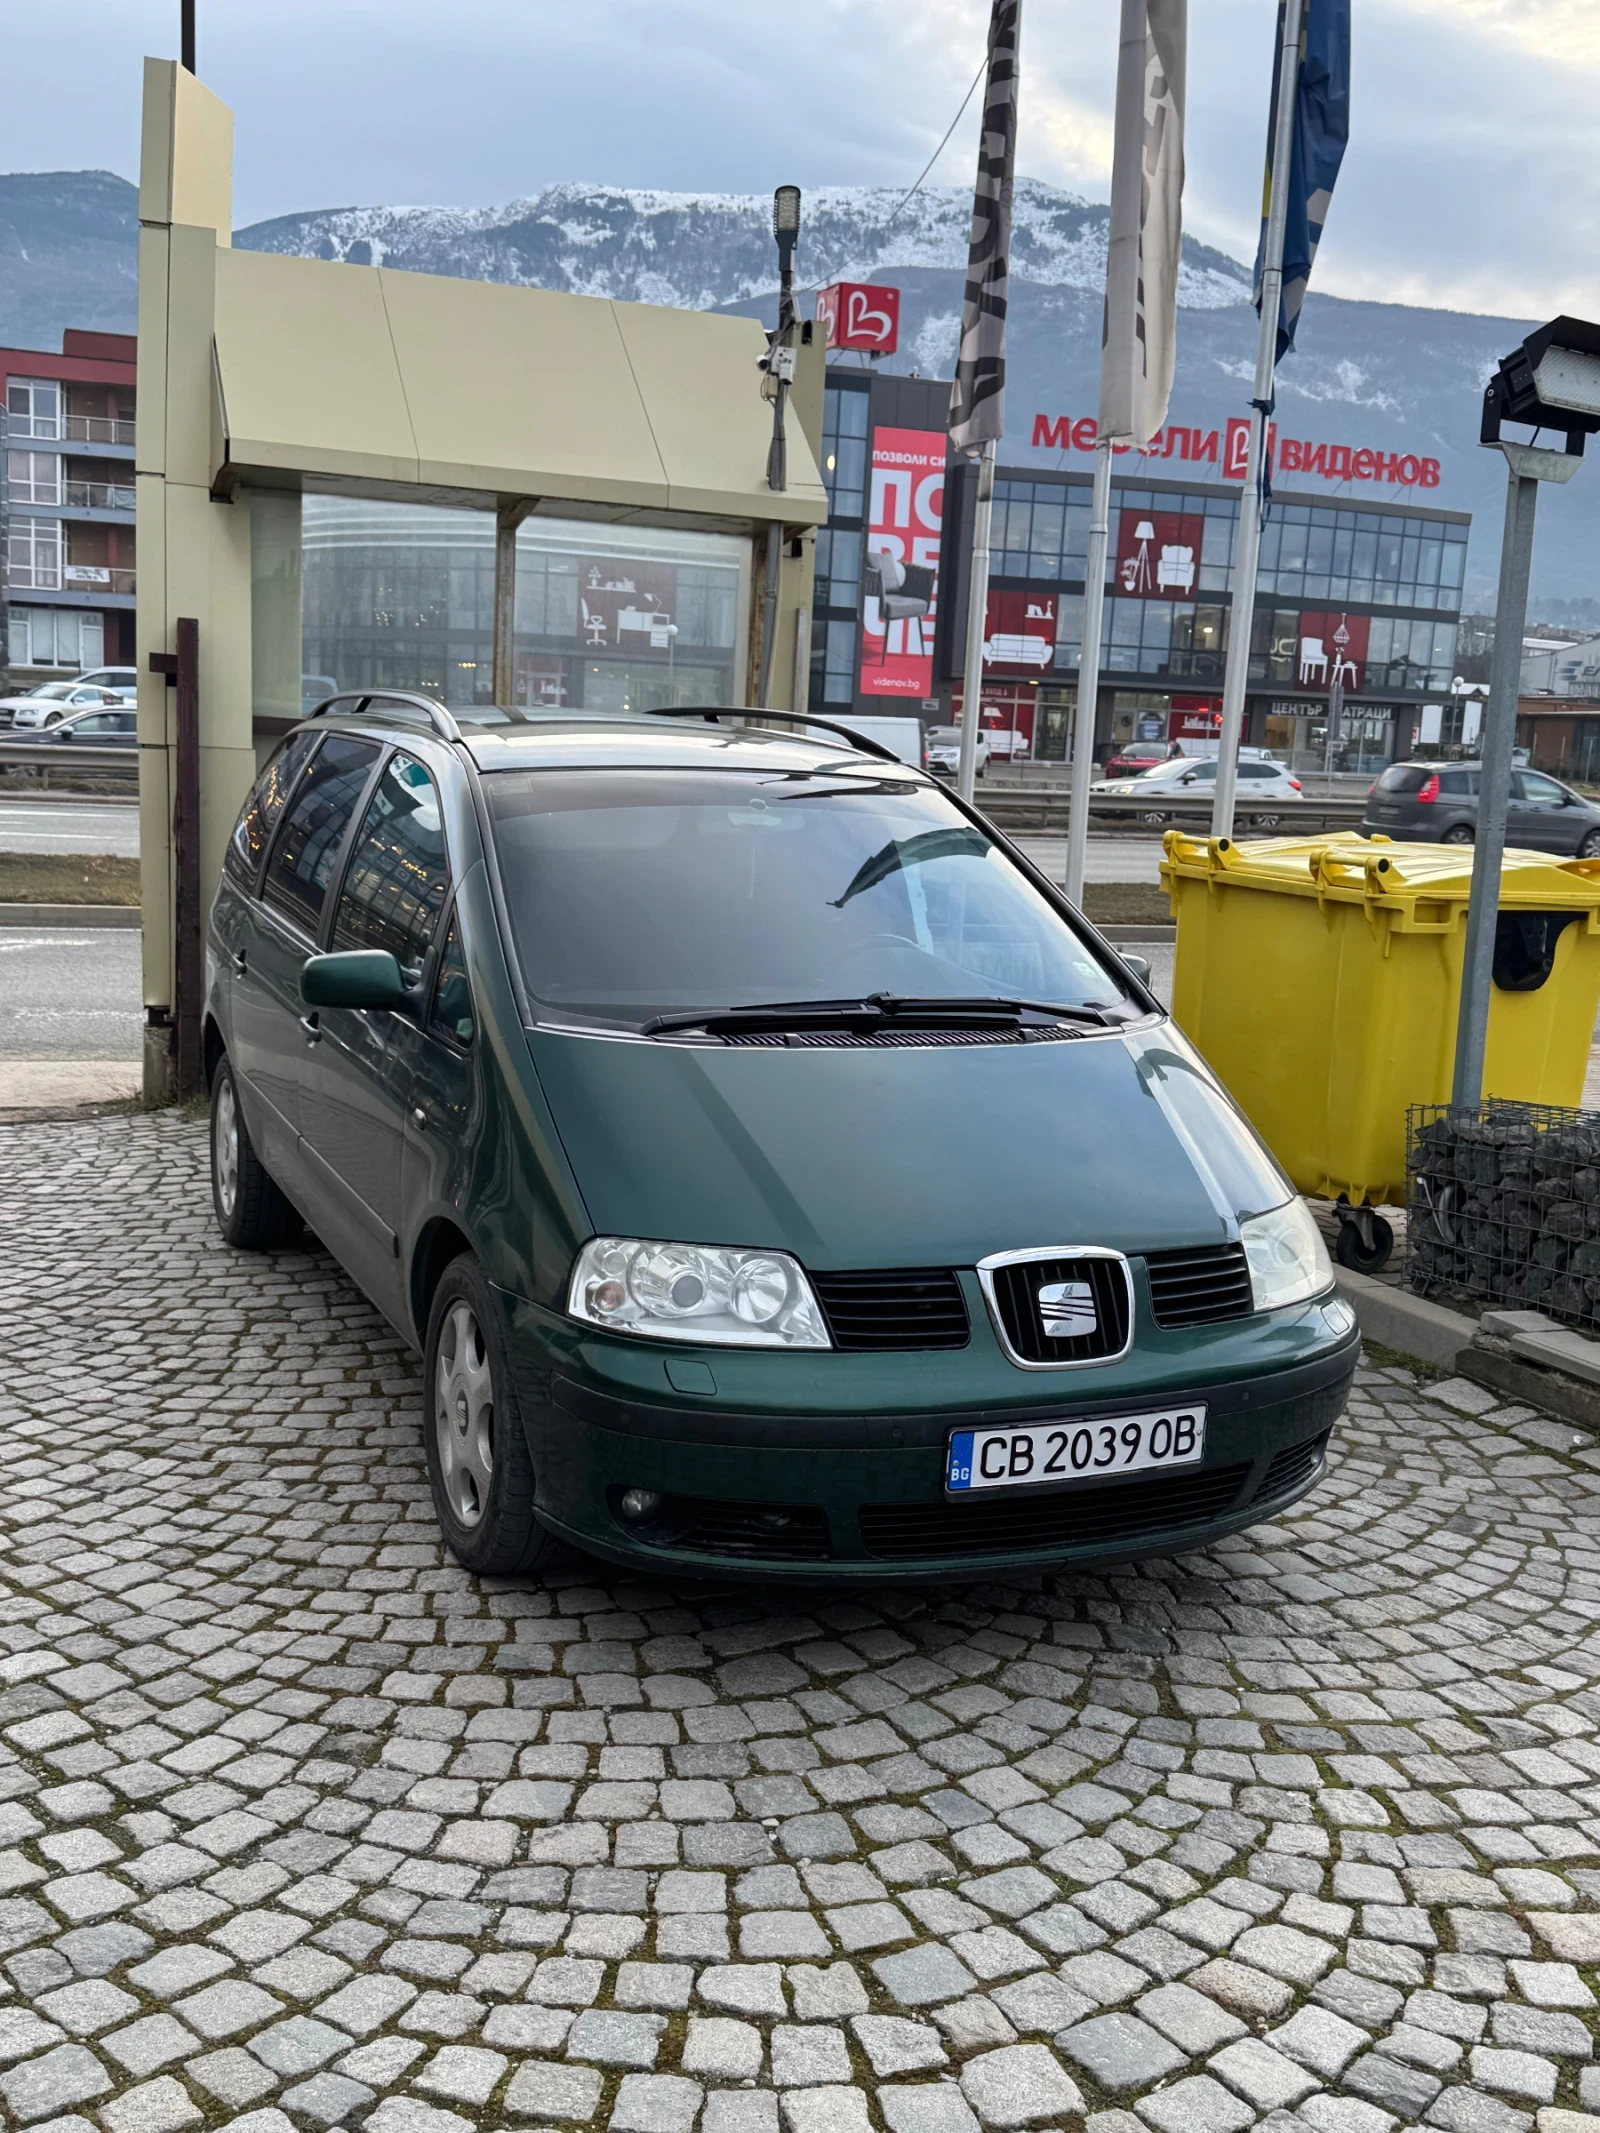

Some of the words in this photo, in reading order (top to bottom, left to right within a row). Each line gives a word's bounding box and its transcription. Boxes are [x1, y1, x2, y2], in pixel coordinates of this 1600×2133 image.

[1031, 414, 1219, 462] меели
[872, 450, 927, 466] ПОЗВОЛИ
[929, 455, 946, 468] СИ
[873, 676, 920, 690] videnov.bg
[1271, 701, 1324, 717] ЦЕНТЪР
[1340, 706, 1392, 721] АТРАЦИ
[950, 1467, 970, 1482] BG
[979, 1434, 1034, 1480] CB
[1043, 1422, 1142, 1475] 2039
[1149, 1413, 1196, 1460] OB
